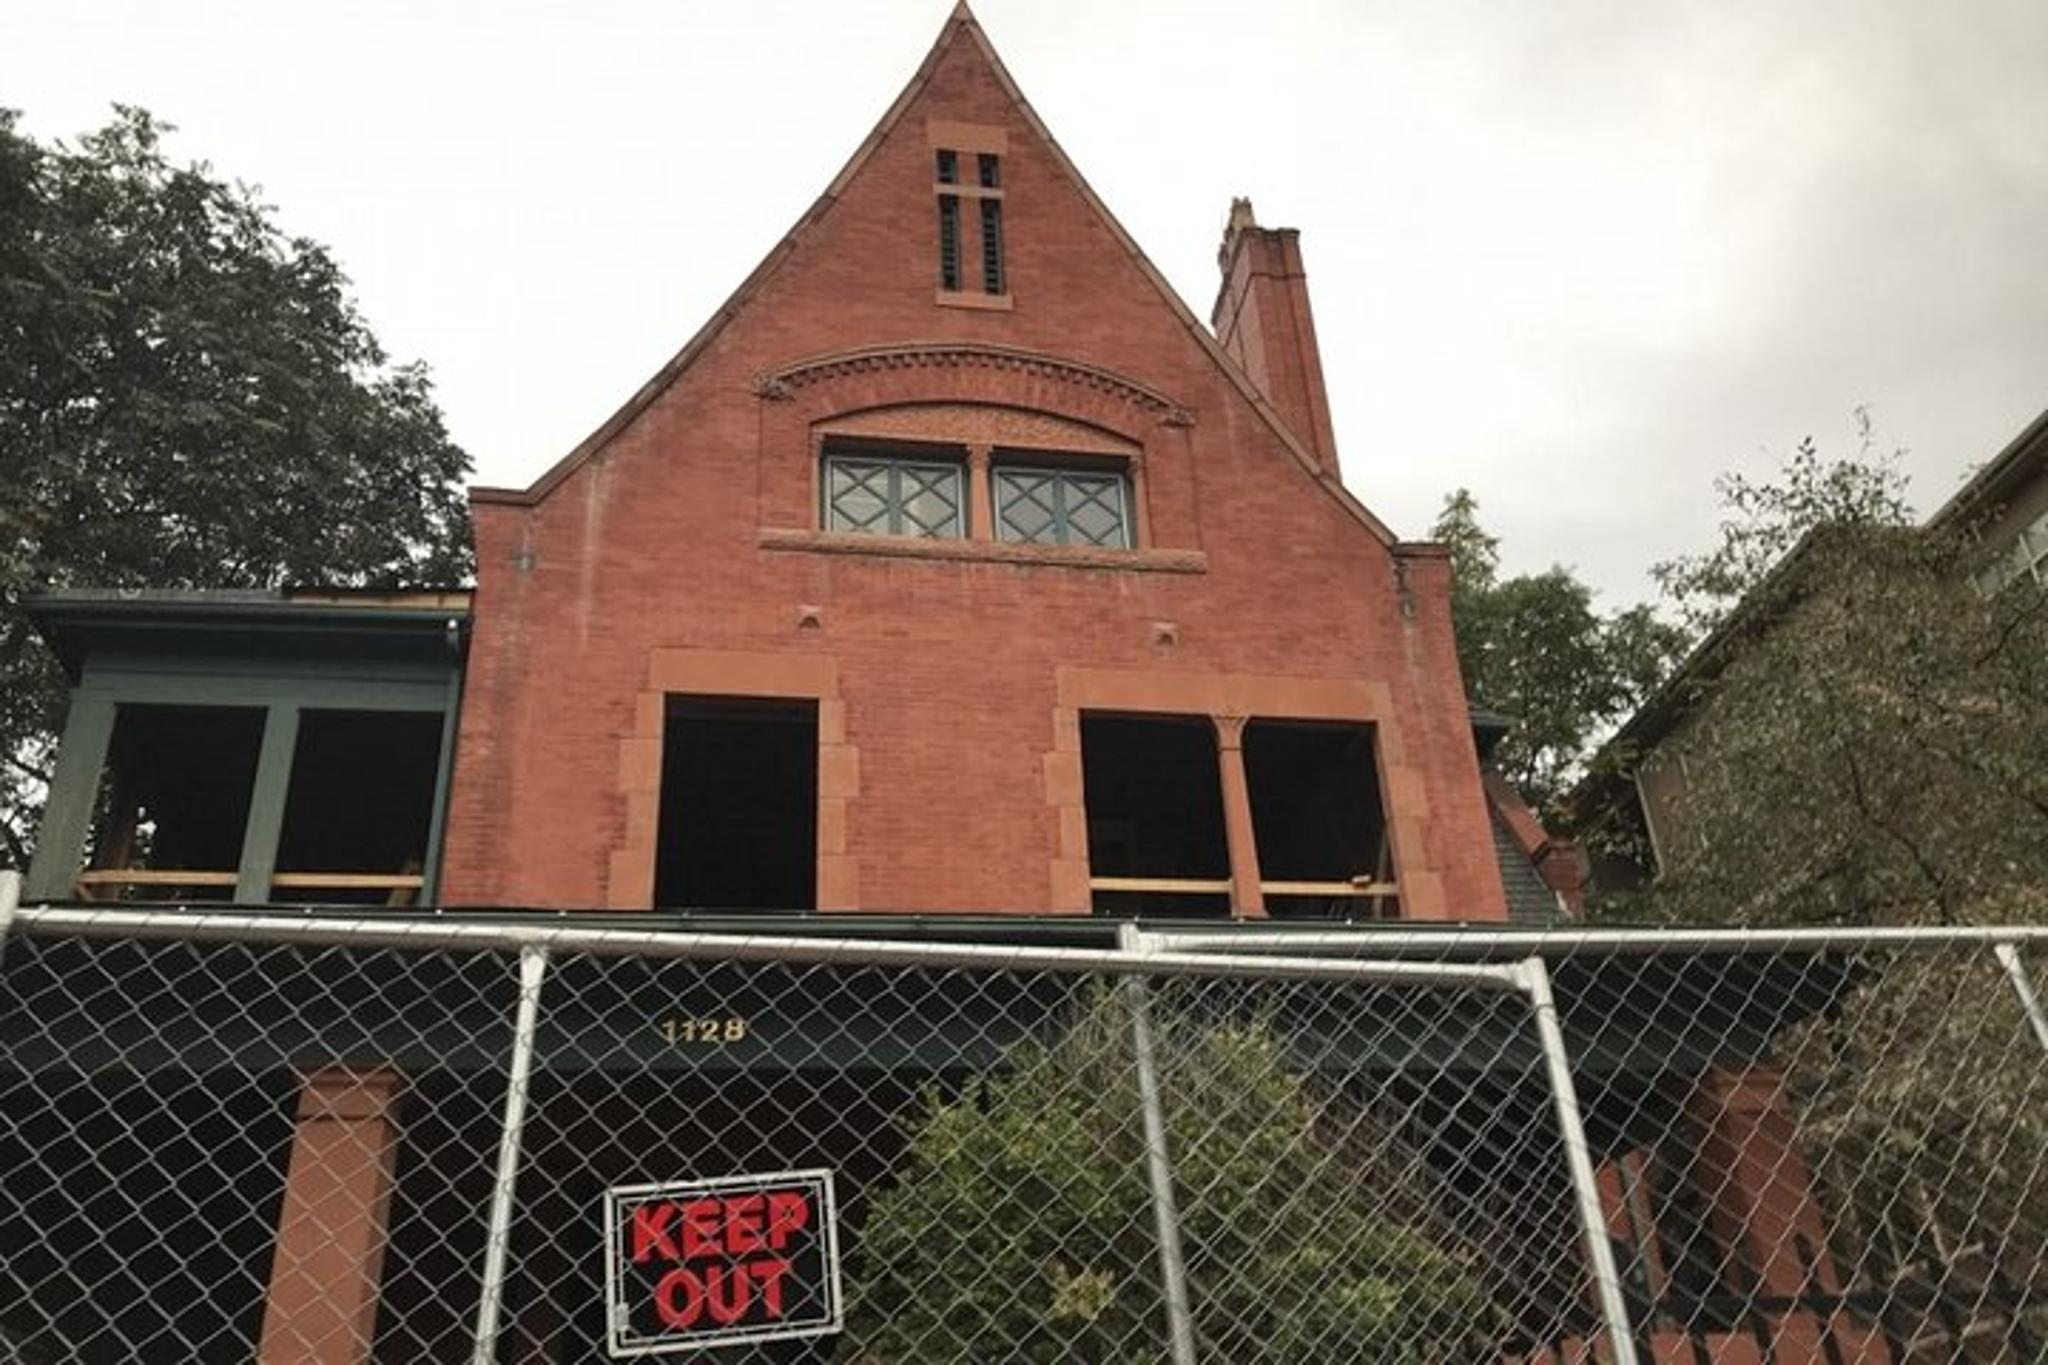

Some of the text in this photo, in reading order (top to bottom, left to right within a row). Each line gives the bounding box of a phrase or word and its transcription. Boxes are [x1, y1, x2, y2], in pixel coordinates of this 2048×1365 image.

[662, 1018, 745, 1042] 1128
[633, 1193, 808, 1263] KEEP
[655, 1260, 791, 1328] OUT
